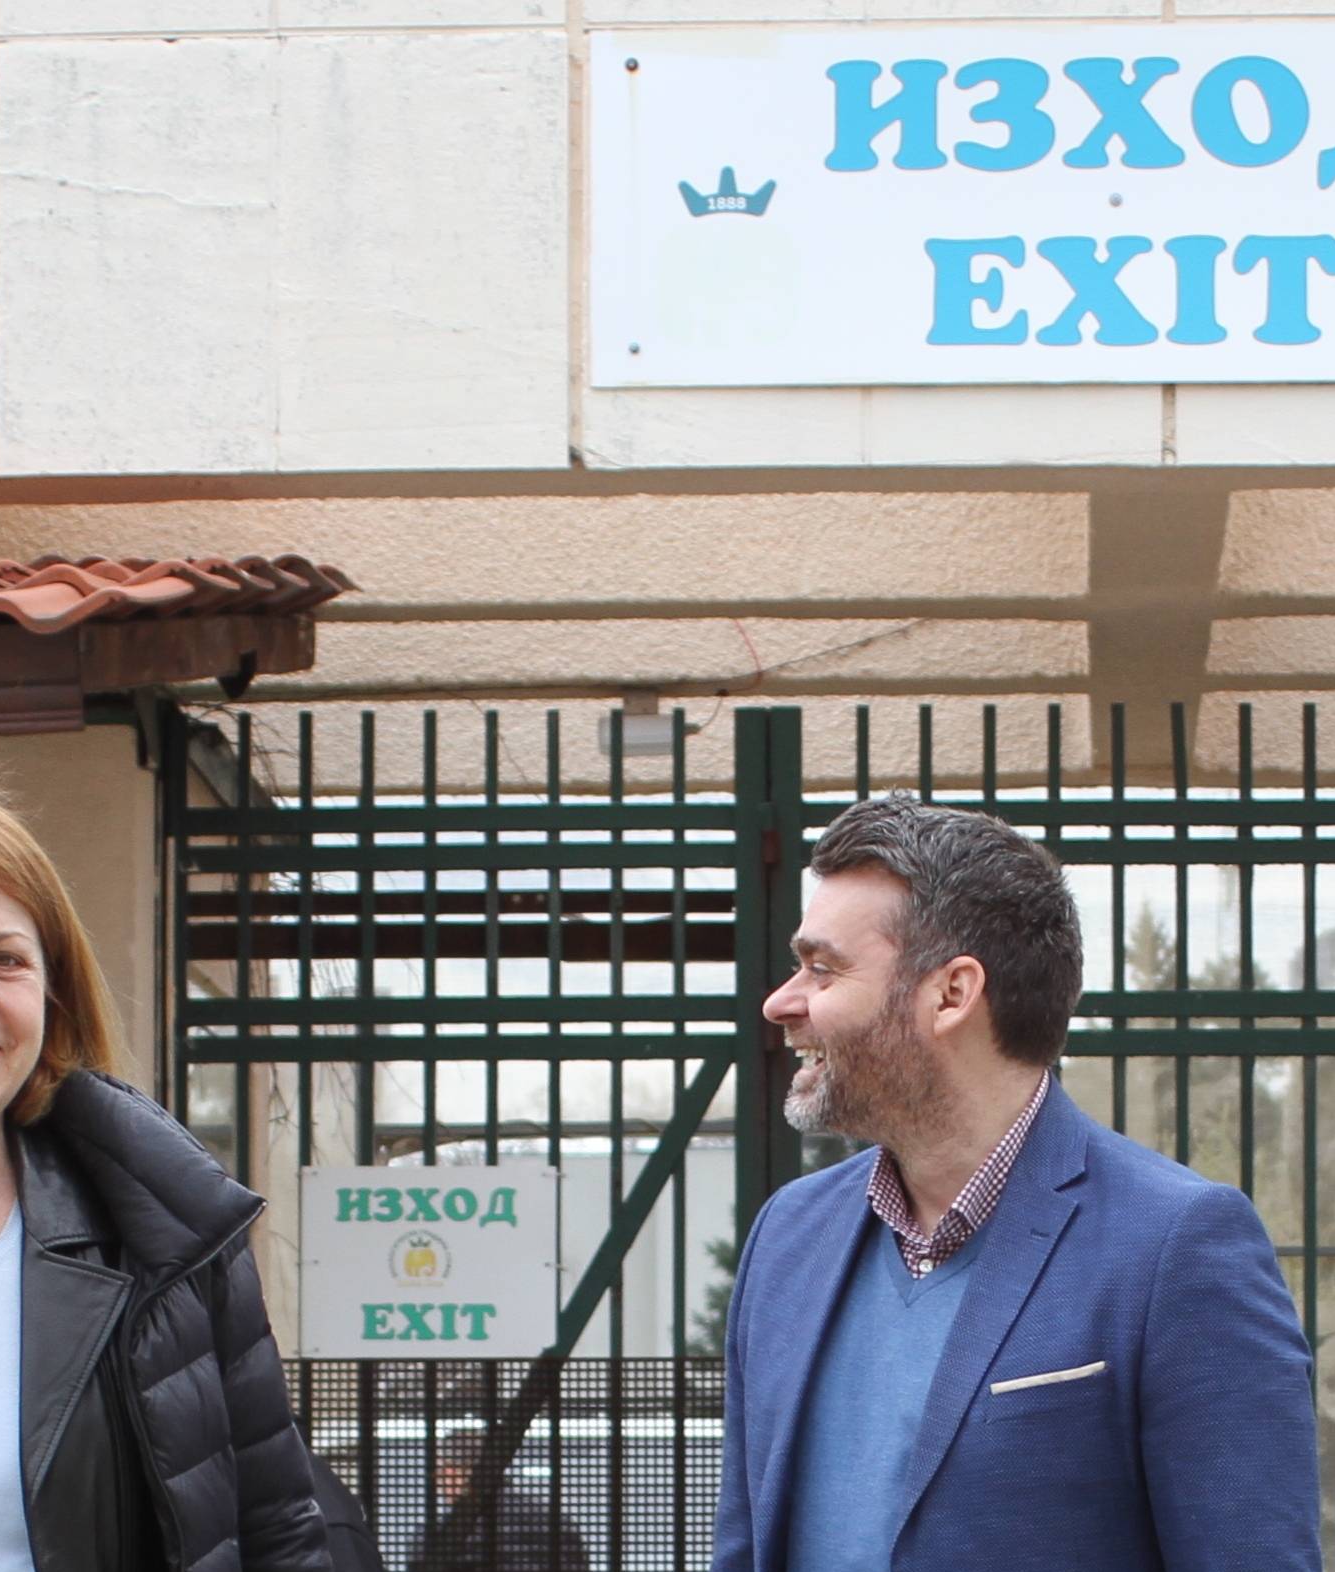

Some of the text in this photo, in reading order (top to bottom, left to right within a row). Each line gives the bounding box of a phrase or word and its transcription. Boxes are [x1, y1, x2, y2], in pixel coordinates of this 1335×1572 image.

[707, 196, 747, 210] 1888
[335, 1187, 517, 1228] ИЗХОД
[360, 1303, 497, 1341] EXIT
